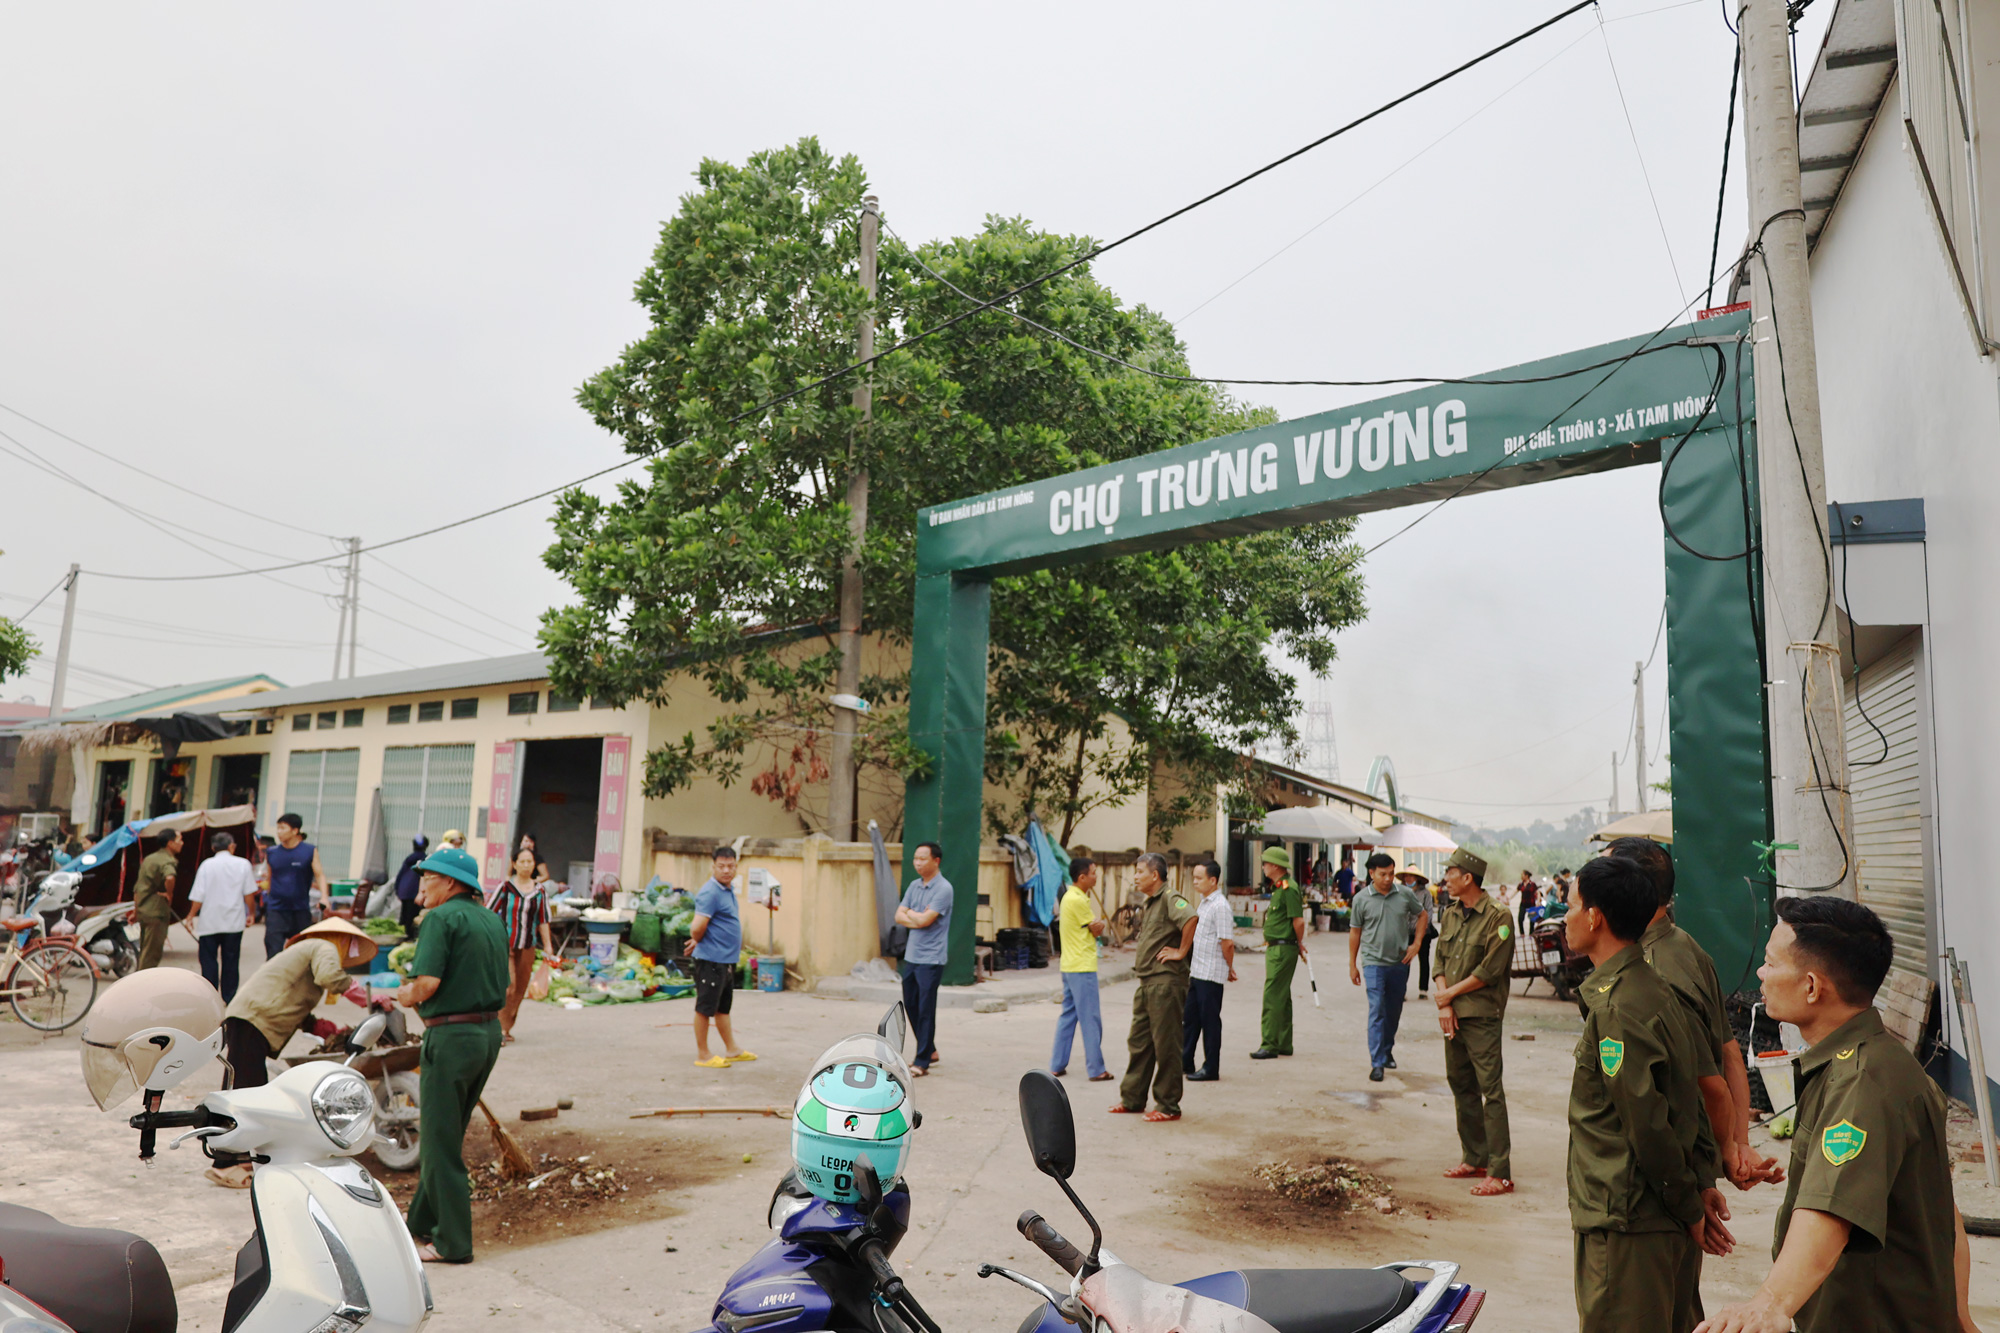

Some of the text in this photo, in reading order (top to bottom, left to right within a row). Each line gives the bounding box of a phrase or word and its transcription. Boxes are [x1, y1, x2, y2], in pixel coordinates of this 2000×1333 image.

[1557, 418, 1595, 445] THÔN
[1597, 417, 1607, 437] 3
[1637, 402, 1669, 427] TAM
[1049, 399, 1468, 536] CHỢ TRƯNG VƯƠNG
[997, 495, 1012, 511] TAM
[821, 1154, 854, 1173] LEOPA
